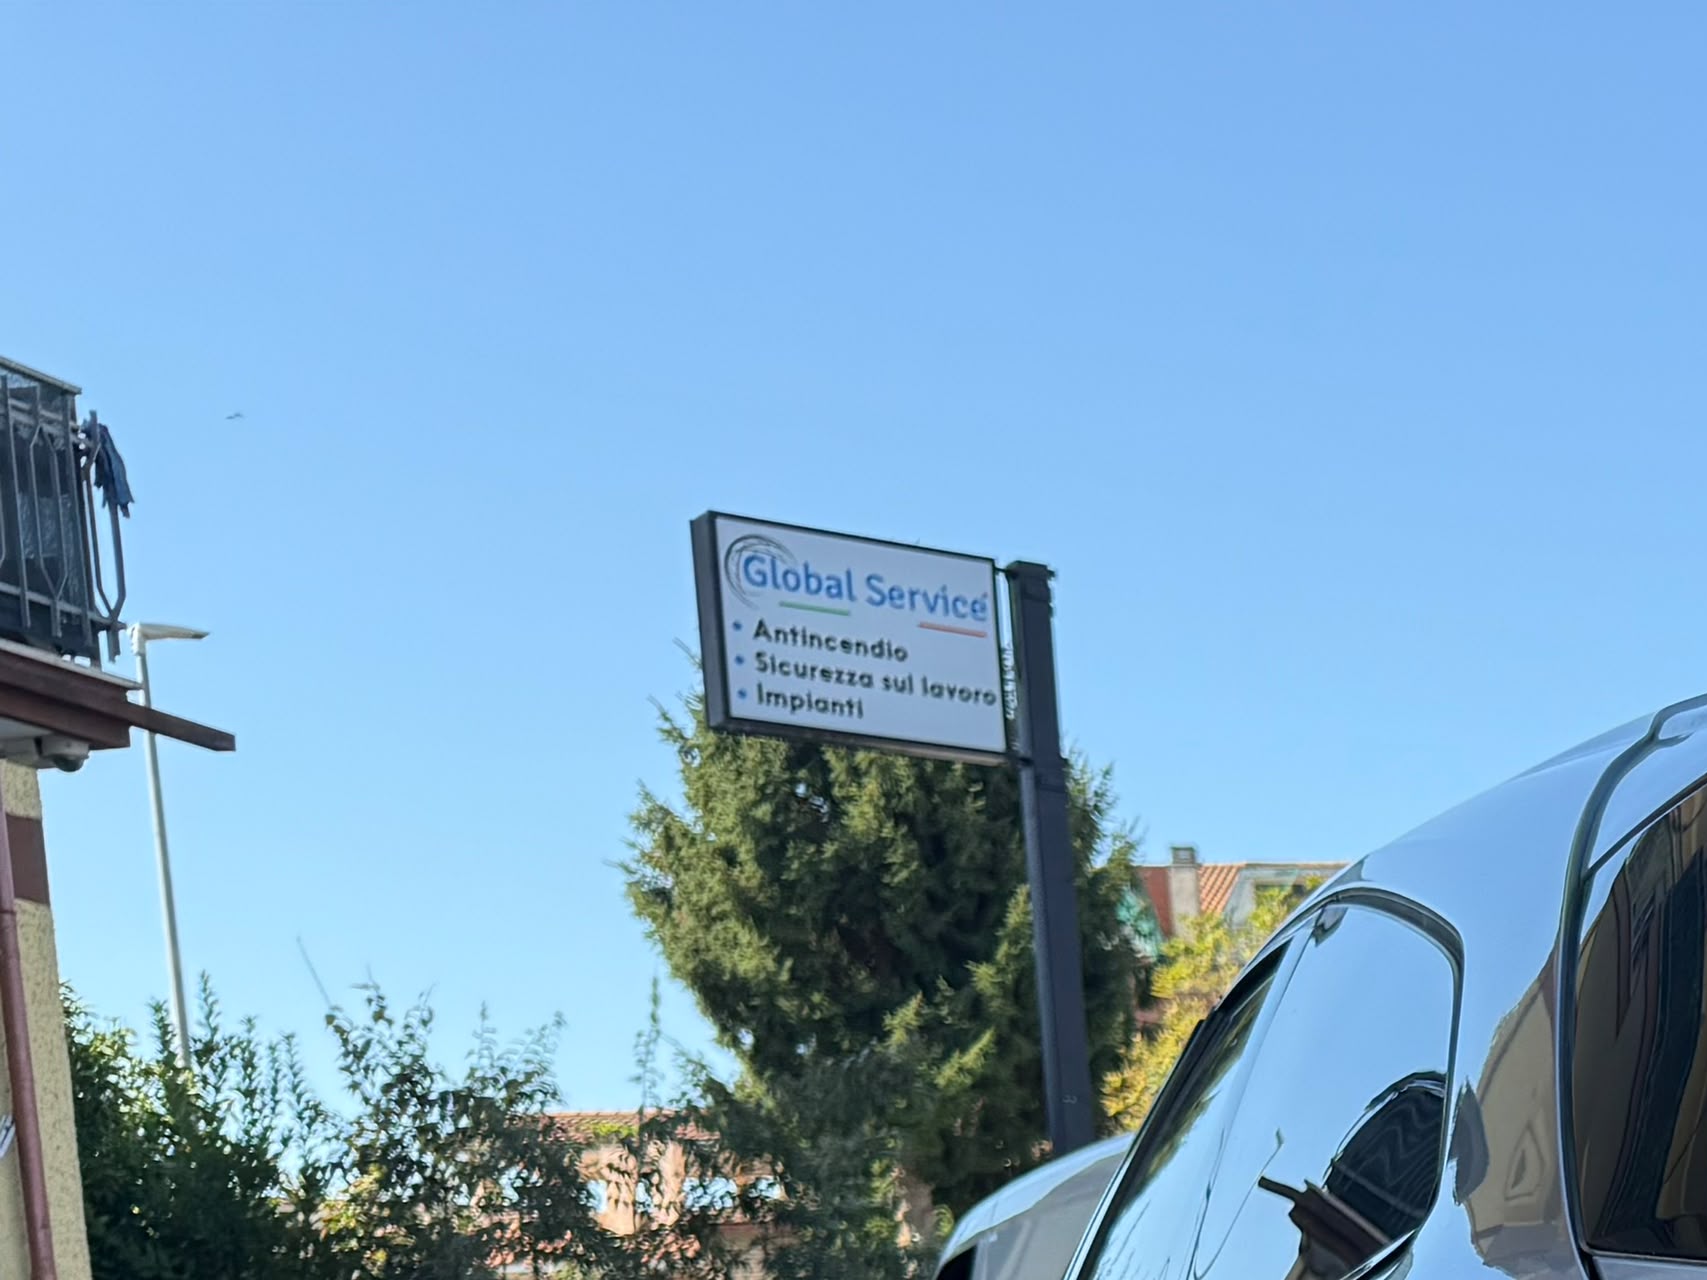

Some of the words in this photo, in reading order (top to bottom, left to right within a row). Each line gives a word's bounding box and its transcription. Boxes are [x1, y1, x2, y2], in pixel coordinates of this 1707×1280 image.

[743, 554, 856, 602] Global
[865, 574, 988, 621] Service
[753, 619, 908, 663] Antincendio
[755, 653, 874, 689] Sicurezza
[882, 672, 915, 694] sul
[922, 678, 997, 707] lavoro
[757, 683, 864, 719] Impianti
